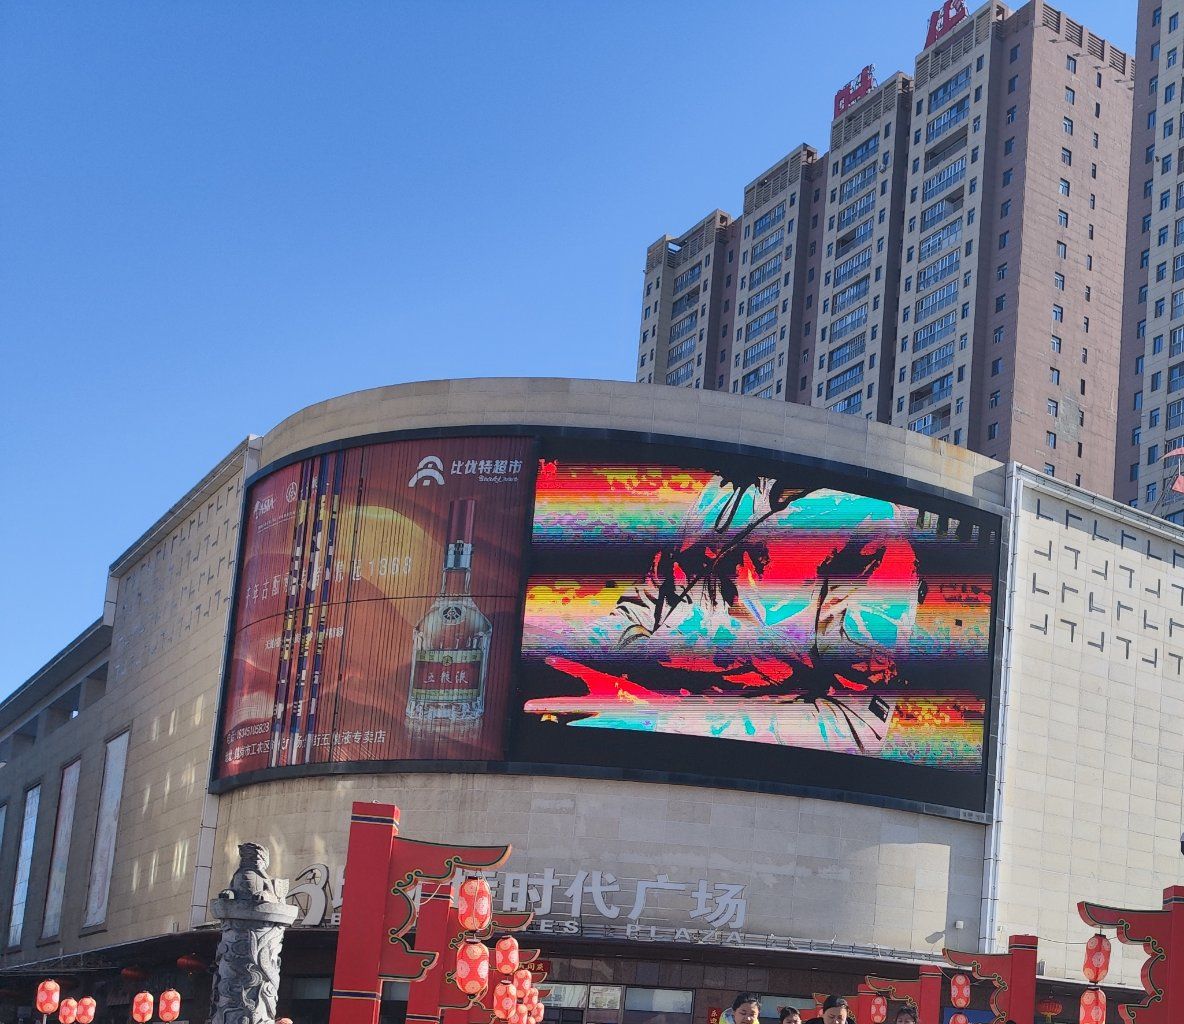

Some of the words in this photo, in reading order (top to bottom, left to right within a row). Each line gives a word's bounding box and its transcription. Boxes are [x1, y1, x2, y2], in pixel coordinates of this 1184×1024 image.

[450, 460, 522, 475] 比优特超市
[626, 923, 744, 943] PLAZA
